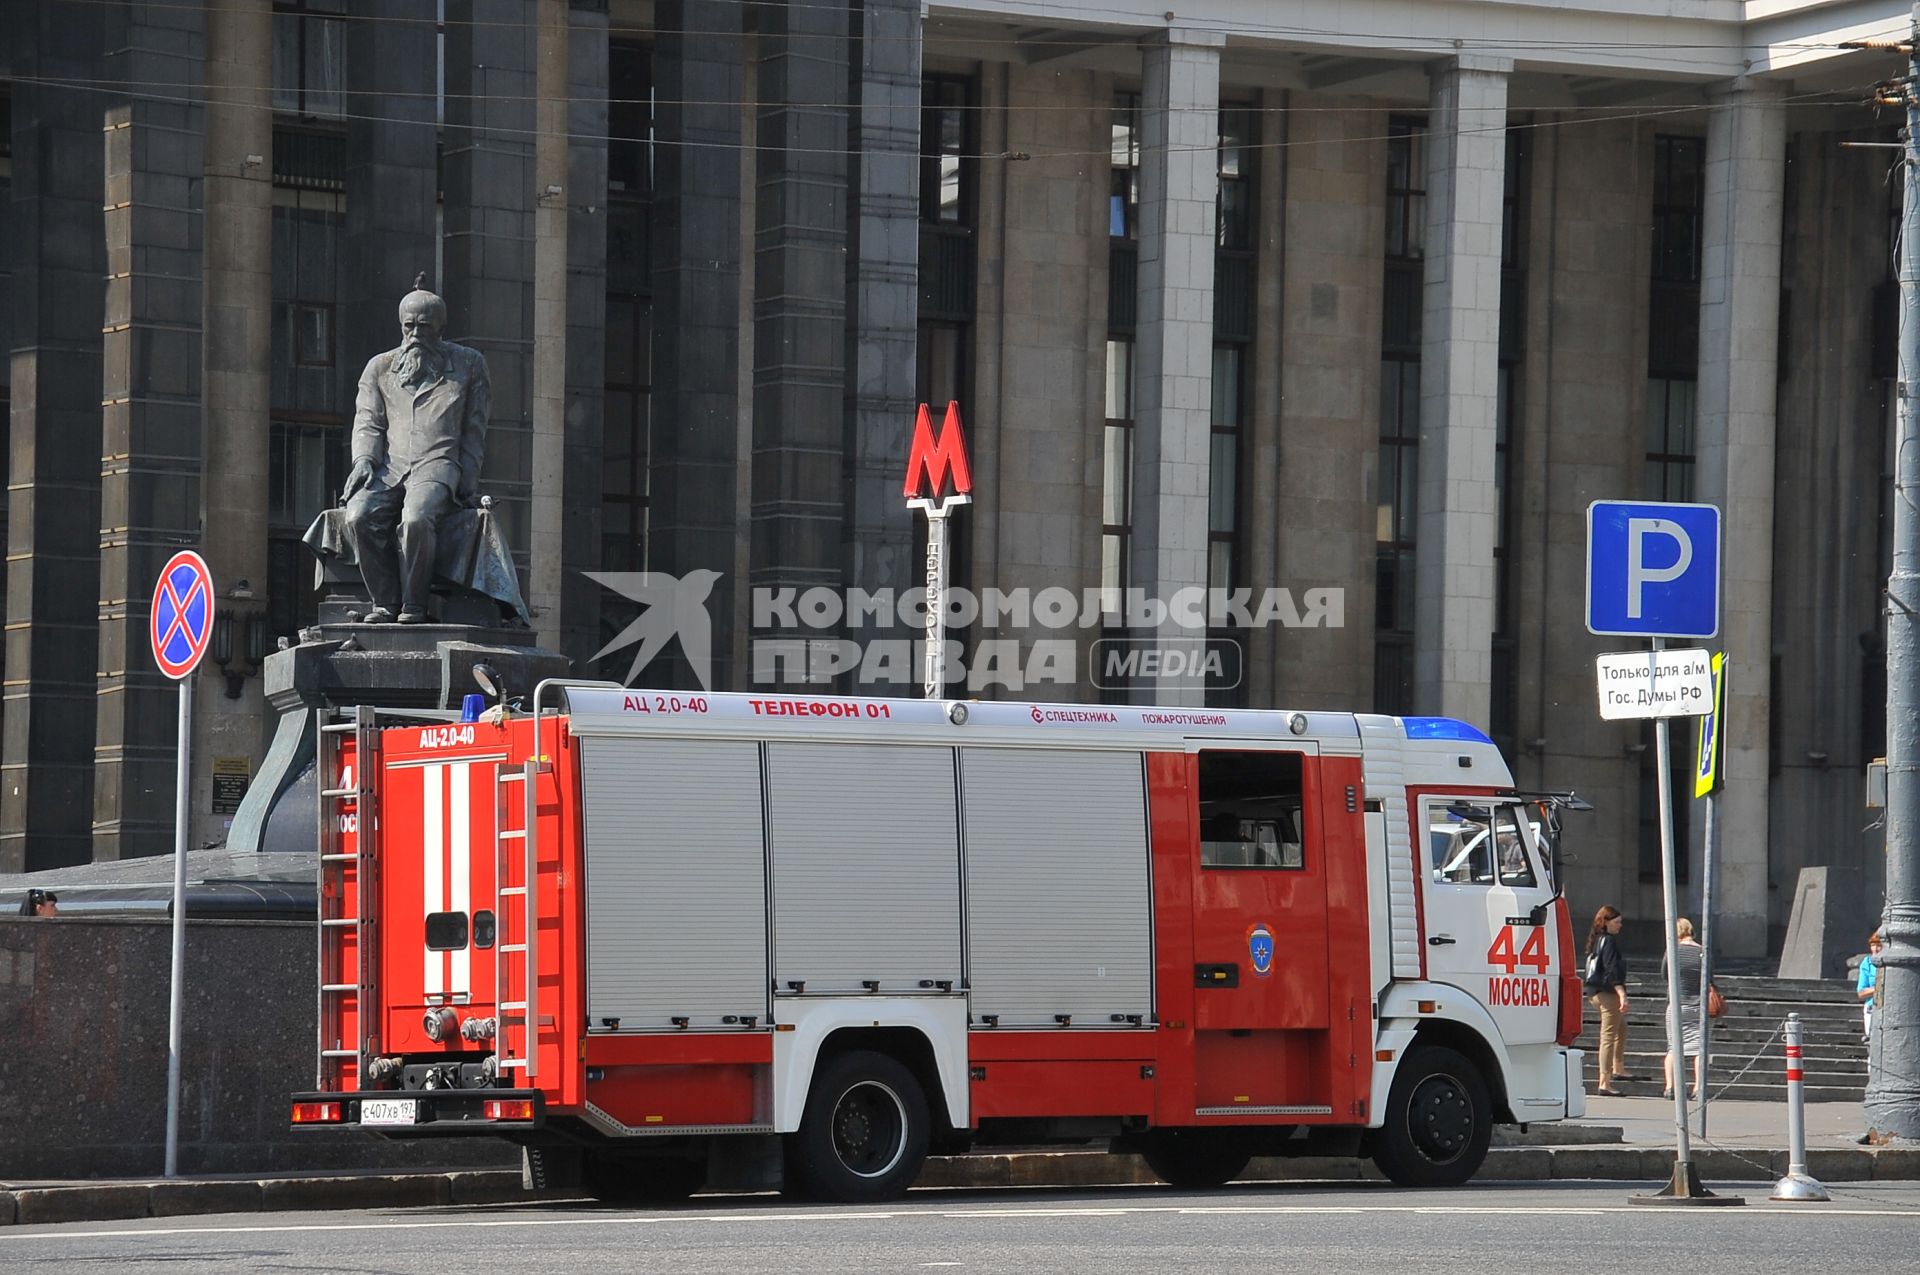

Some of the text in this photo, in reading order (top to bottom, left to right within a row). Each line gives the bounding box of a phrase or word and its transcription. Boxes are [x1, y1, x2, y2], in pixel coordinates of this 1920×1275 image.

[903, 400, 972, 497] М
[1627, 518, 1692, 618] P
[1602, 661, 1705, 680] Только для а/м
[623, 696, 708, 714] АЦ 2,0-40
[1608, 686, 1702, 706] Гос. Думы РФ
[749, 701, 890, 718] ТЕЛЕФОН 01
[1045, 710, 1227, 726] СПЕЦТЕХНИКА ПОЖАРОТУШЕНИЯ
[1487, 925, 1550, 975] 44
[1488, 977, 1550, 1007] МОСКВА
